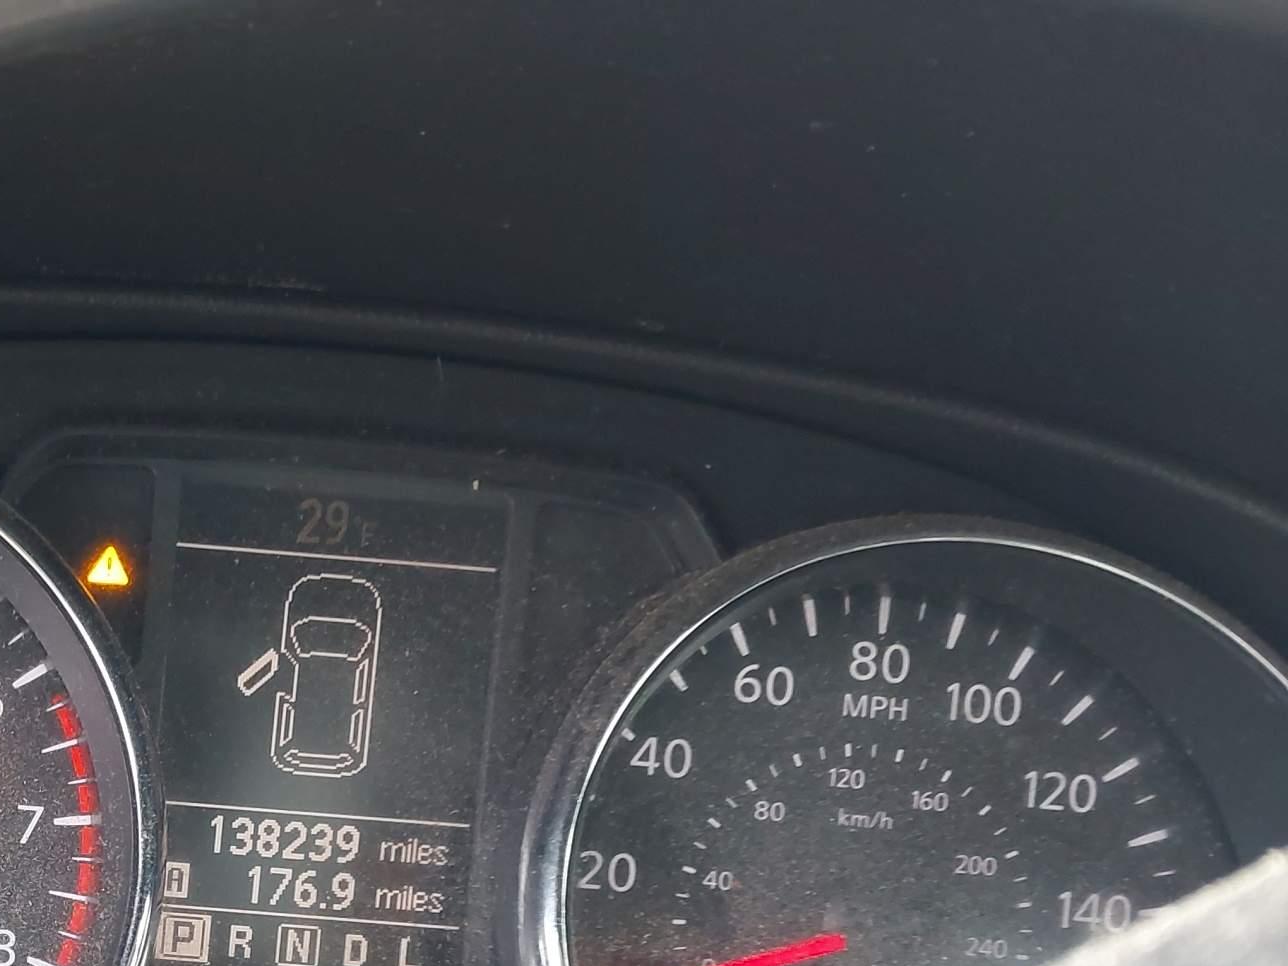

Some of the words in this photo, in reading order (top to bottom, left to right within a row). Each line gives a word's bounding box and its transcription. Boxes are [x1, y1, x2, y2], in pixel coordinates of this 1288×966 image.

[296, 498, 350, 544] 29
[850, 641, 910, 685] 80
[733, 665, 795, 706] 60
[946, 684, 1021, 726] 100
[843, 694, 909, 722] MPH
[630, 736, 692, 779] 40
[828, 768, 865, 790] 120
[1024, 772, 1097, 813] 120
[754, 801, 785, 822] 80
[838, 809, 894, 830] km/h
[912, 791, 949, 813] 160
[17, 804, 45, 844] 7
[211, 815, 359, 861] 138239
[380, 838, 449, 867] miles
[579, 851, 637, 892] 20
[703, 871, 733, 891] 40
[955, 855, 998, 876] 200
[248, 866, 355, 911] 176.9
[375, 884, 445, 914] miles
[1059, 892, 1130, 933] 140
[229, 925, 253, 958] R
[285, 928, 311, 963] N
[343, 934, 368, 966] D
[967, 938, 1008, 959] 240
